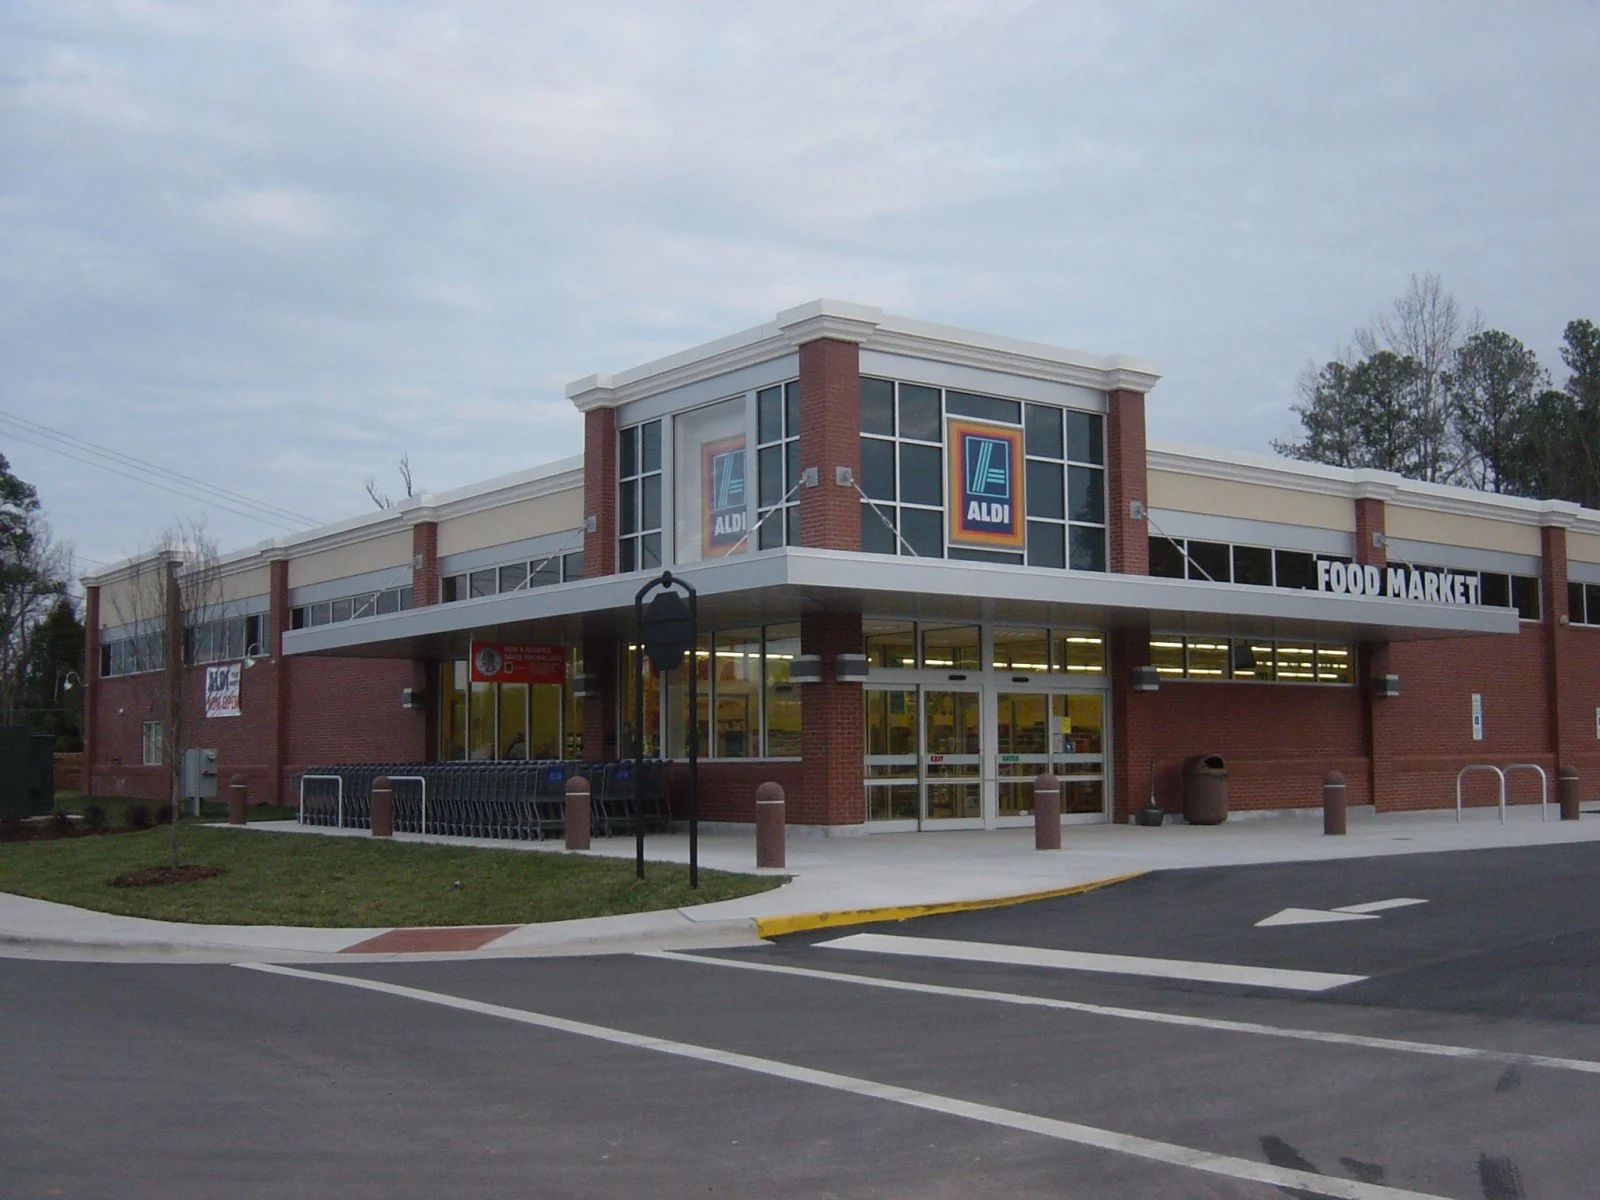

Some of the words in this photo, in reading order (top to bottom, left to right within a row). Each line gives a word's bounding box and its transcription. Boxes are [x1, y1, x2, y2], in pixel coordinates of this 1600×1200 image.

[714, 512, 747, 536] ALDI
[967, 500, 1009, 524] ALDI
[1317, 560, 1381, 597] FOOD
[1386, 567, 1478, 605] MARKET
